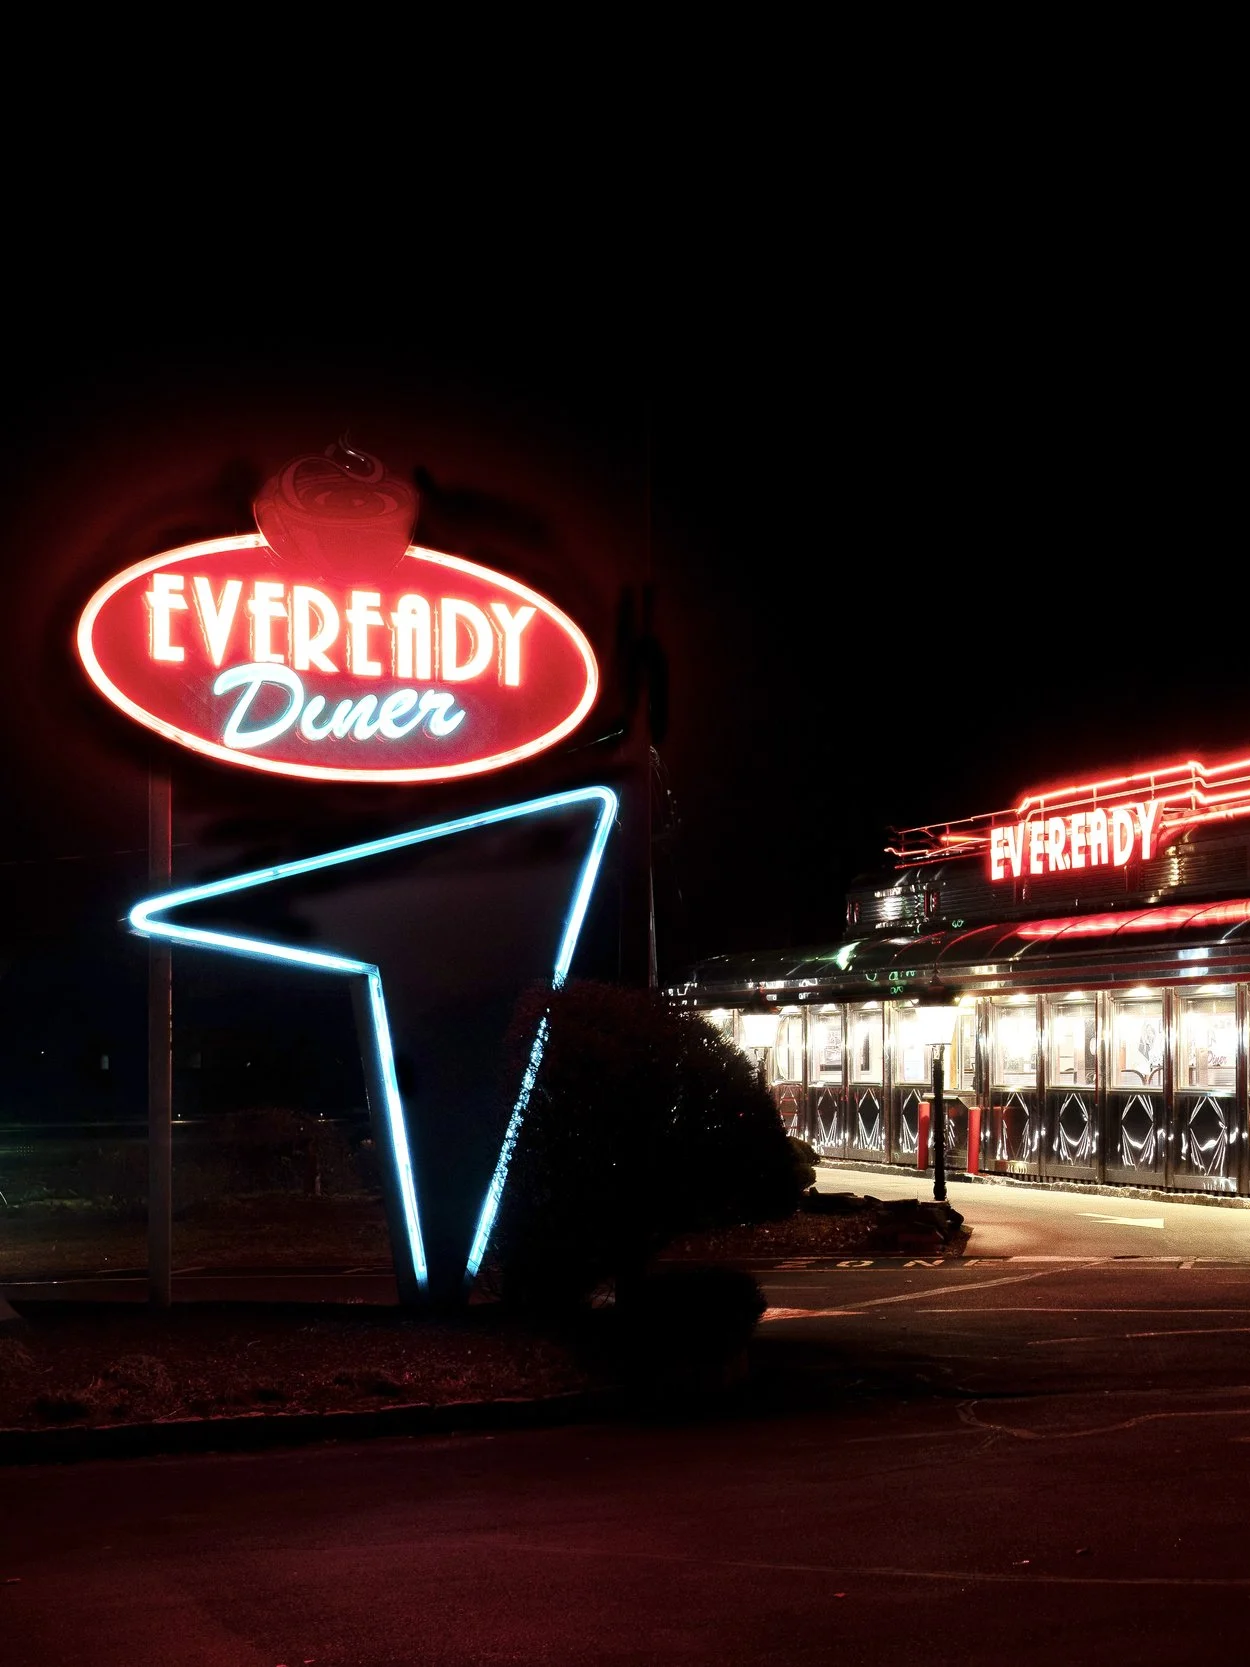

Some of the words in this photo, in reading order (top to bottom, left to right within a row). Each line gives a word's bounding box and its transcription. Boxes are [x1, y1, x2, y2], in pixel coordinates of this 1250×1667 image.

[147, 573, 537, 687] EVEREADY
[213, 661, 466, 748] Diner
[991, 799, 1160, 881] EVEREADY
